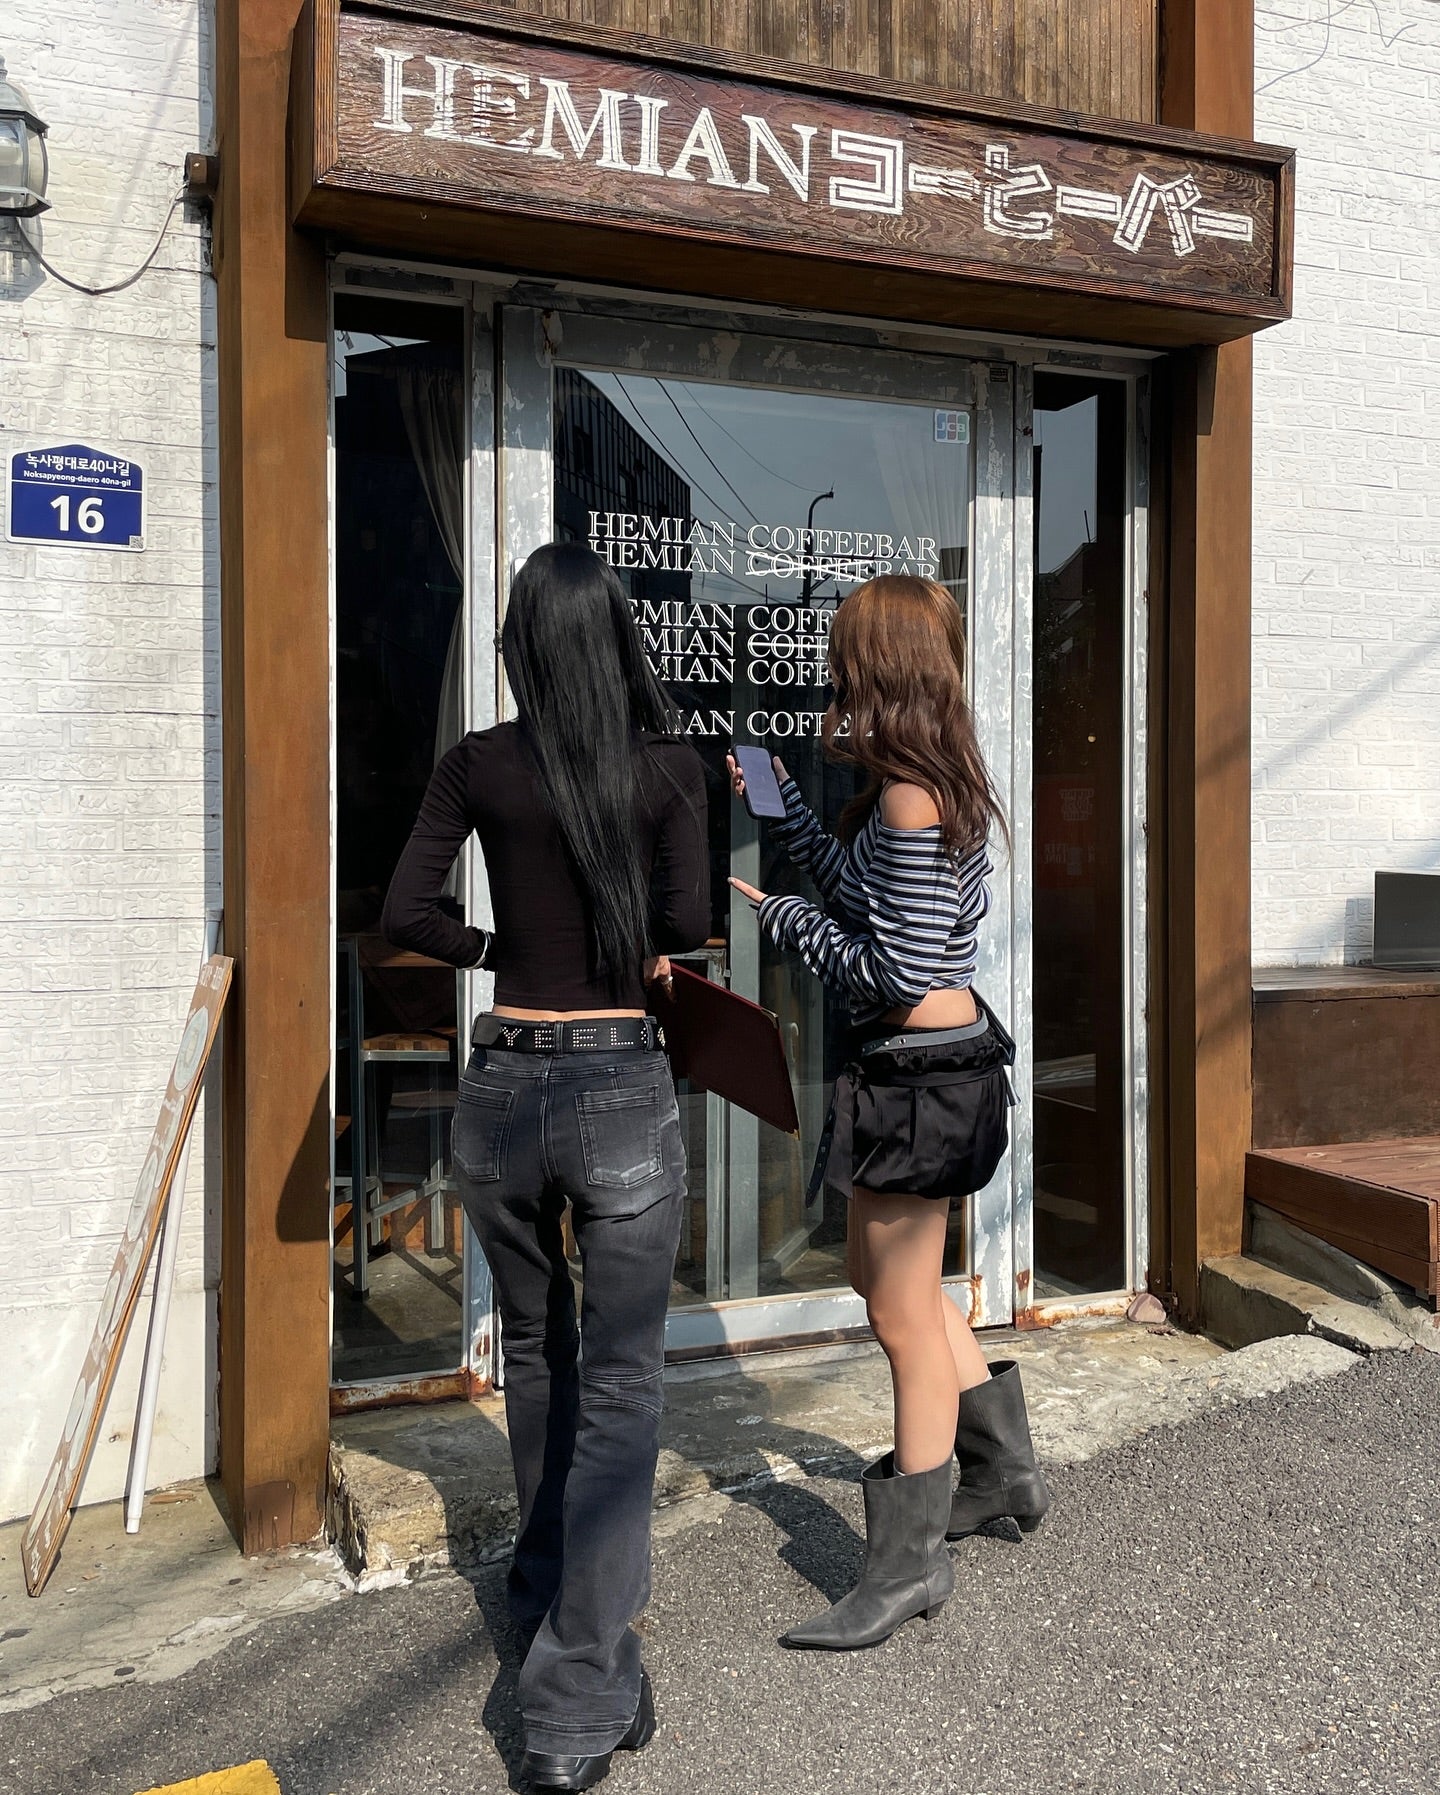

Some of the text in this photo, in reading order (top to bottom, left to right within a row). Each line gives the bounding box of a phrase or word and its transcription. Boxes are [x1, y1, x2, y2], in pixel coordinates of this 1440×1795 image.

[373, 47, 818, 202] HEMIAN
[937, 421, 966, 433] JCB
[23, 470, 131, 488] Noksapyeong-daero 40na-gil
[25, 453, 130, 477] 녹사평대로40나길
[50, 495, 105, 534] 16
[588, 510, 941, 563] HEMIAN COFFEEBAR
[588, 539, 736, 575] HEMIAN
[747, 605, 839, 633] COFF
